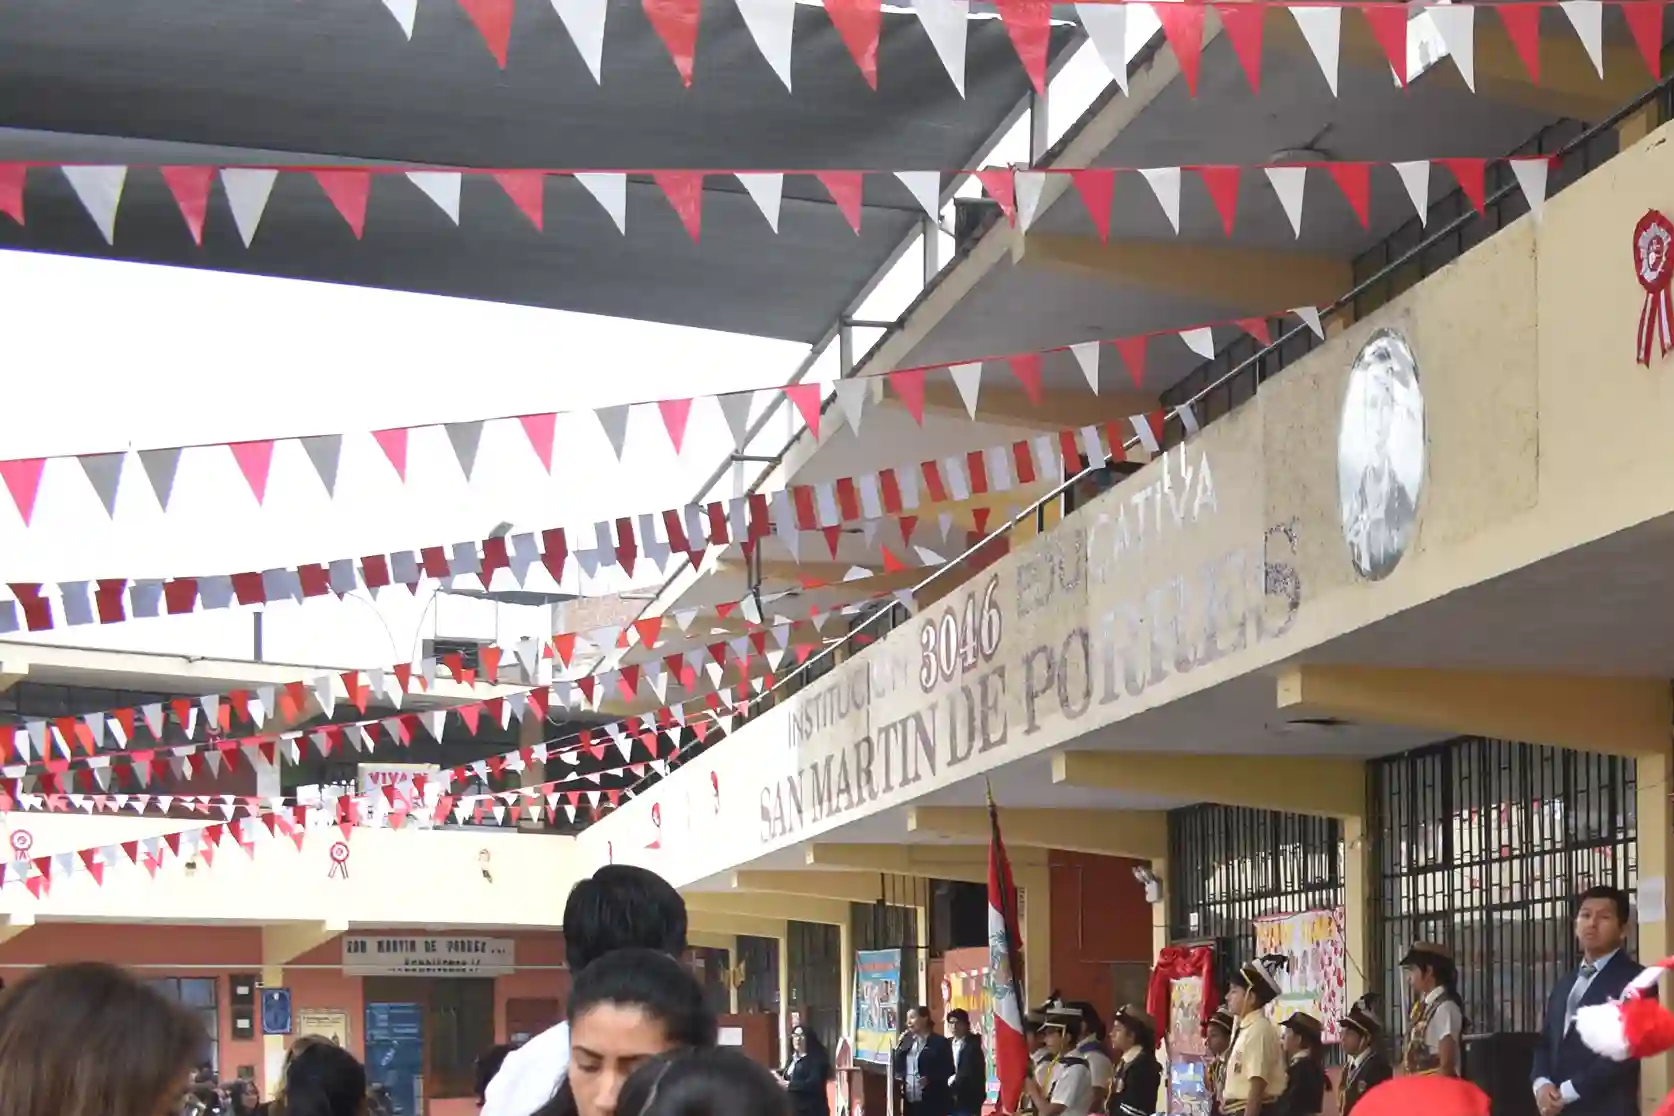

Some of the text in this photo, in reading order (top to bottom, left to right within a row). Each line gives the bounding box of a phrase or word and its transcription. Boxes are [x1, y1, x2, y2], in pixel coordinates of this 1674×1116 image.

[920, 574, 1001, 693] 3046
[1016, 441, 1218, 618] EDUCATIVA
[760, 769, 804, 843] SAN
[810, 702, 938, 824] MARTIN
[946, 665, 1007, 767] DE
[424, 940, 437, 953] DE
